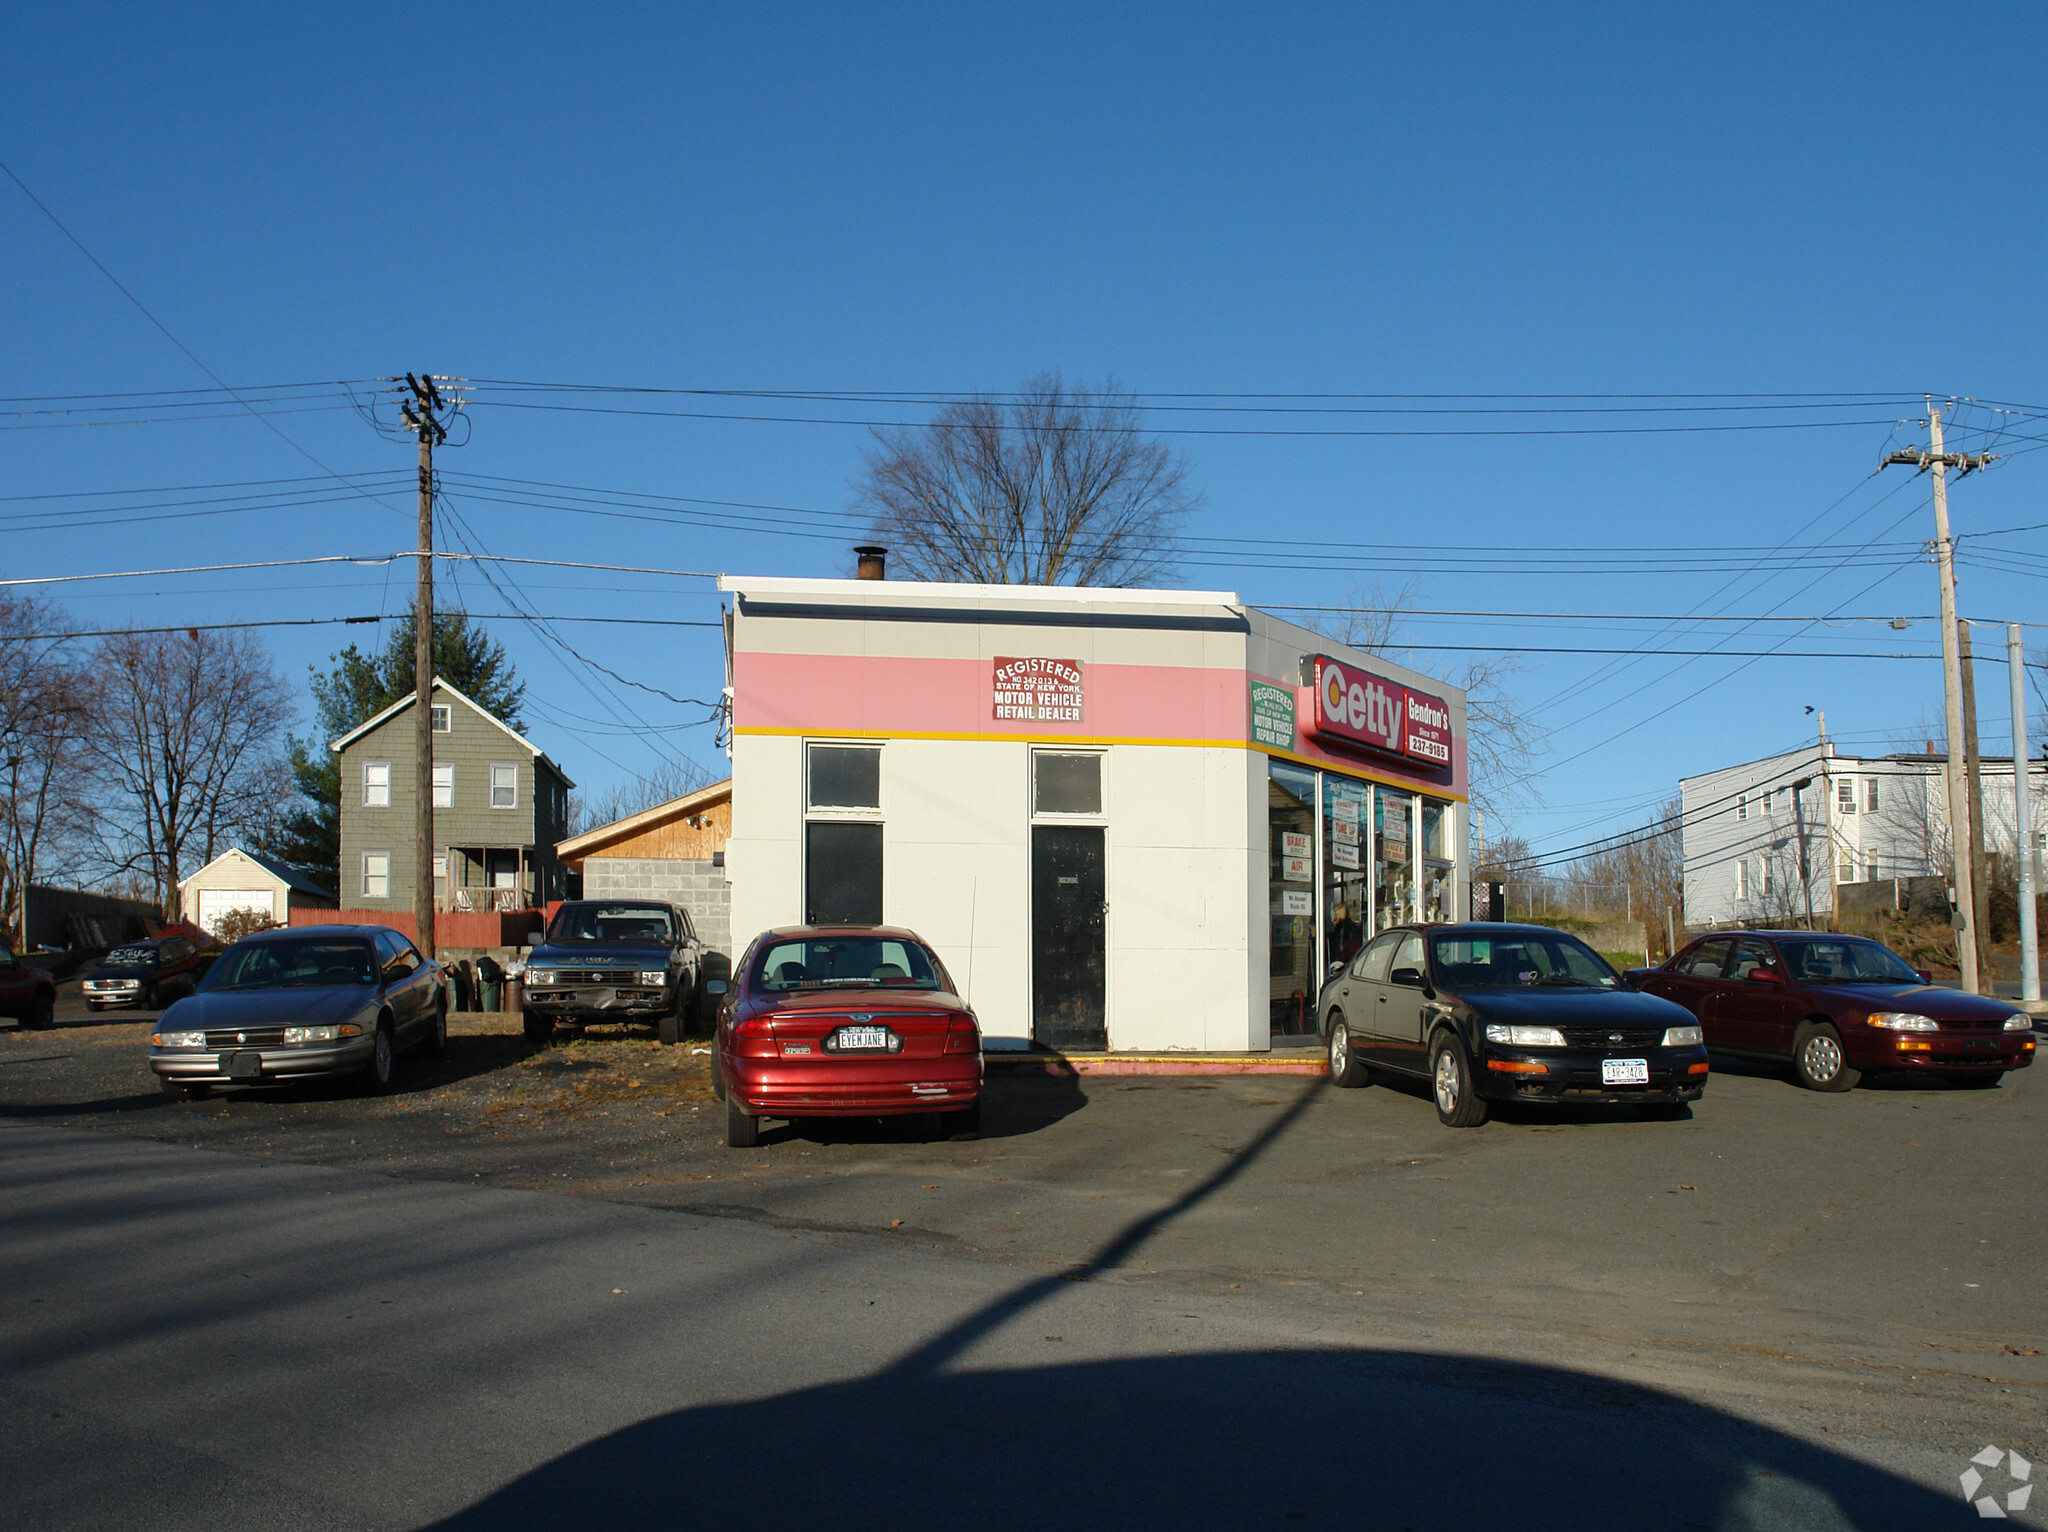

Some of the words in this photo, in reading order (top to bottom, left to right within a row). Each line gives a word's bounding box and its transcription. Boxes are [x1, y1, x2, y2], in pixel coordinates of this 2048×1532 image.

[996, 659, 1079, 683] REGISTERED
[996, 682, 1021, 690] STATE
[1024, 683, 1035, 691] OF
[994, 691, 1033, 704] MOTOR
[1036, 692, 1082, 706] VEHICLE
[1253, 687, 1292, 711] REGISTERED
[1321, 664, 1402, 750] Getty
[996, 705, 1034, 719] RETAIL
[1038, 707, 1080, 720] DEALER
[1408, 696, 1448, 731] Gendron's
[1254, 713, 1272, 730] MOTOR
[1272, 718, 1292, 735] VEHICLE
[1256, 727, 1275, 744] REPAIR
[1276, 731, 1290, 747] SHOP
[1412, 738, 1445, 758] 237-9185
[1287, 835, 1306, 848] BRAKE
[1291, 860, 1304, 872] AIR
